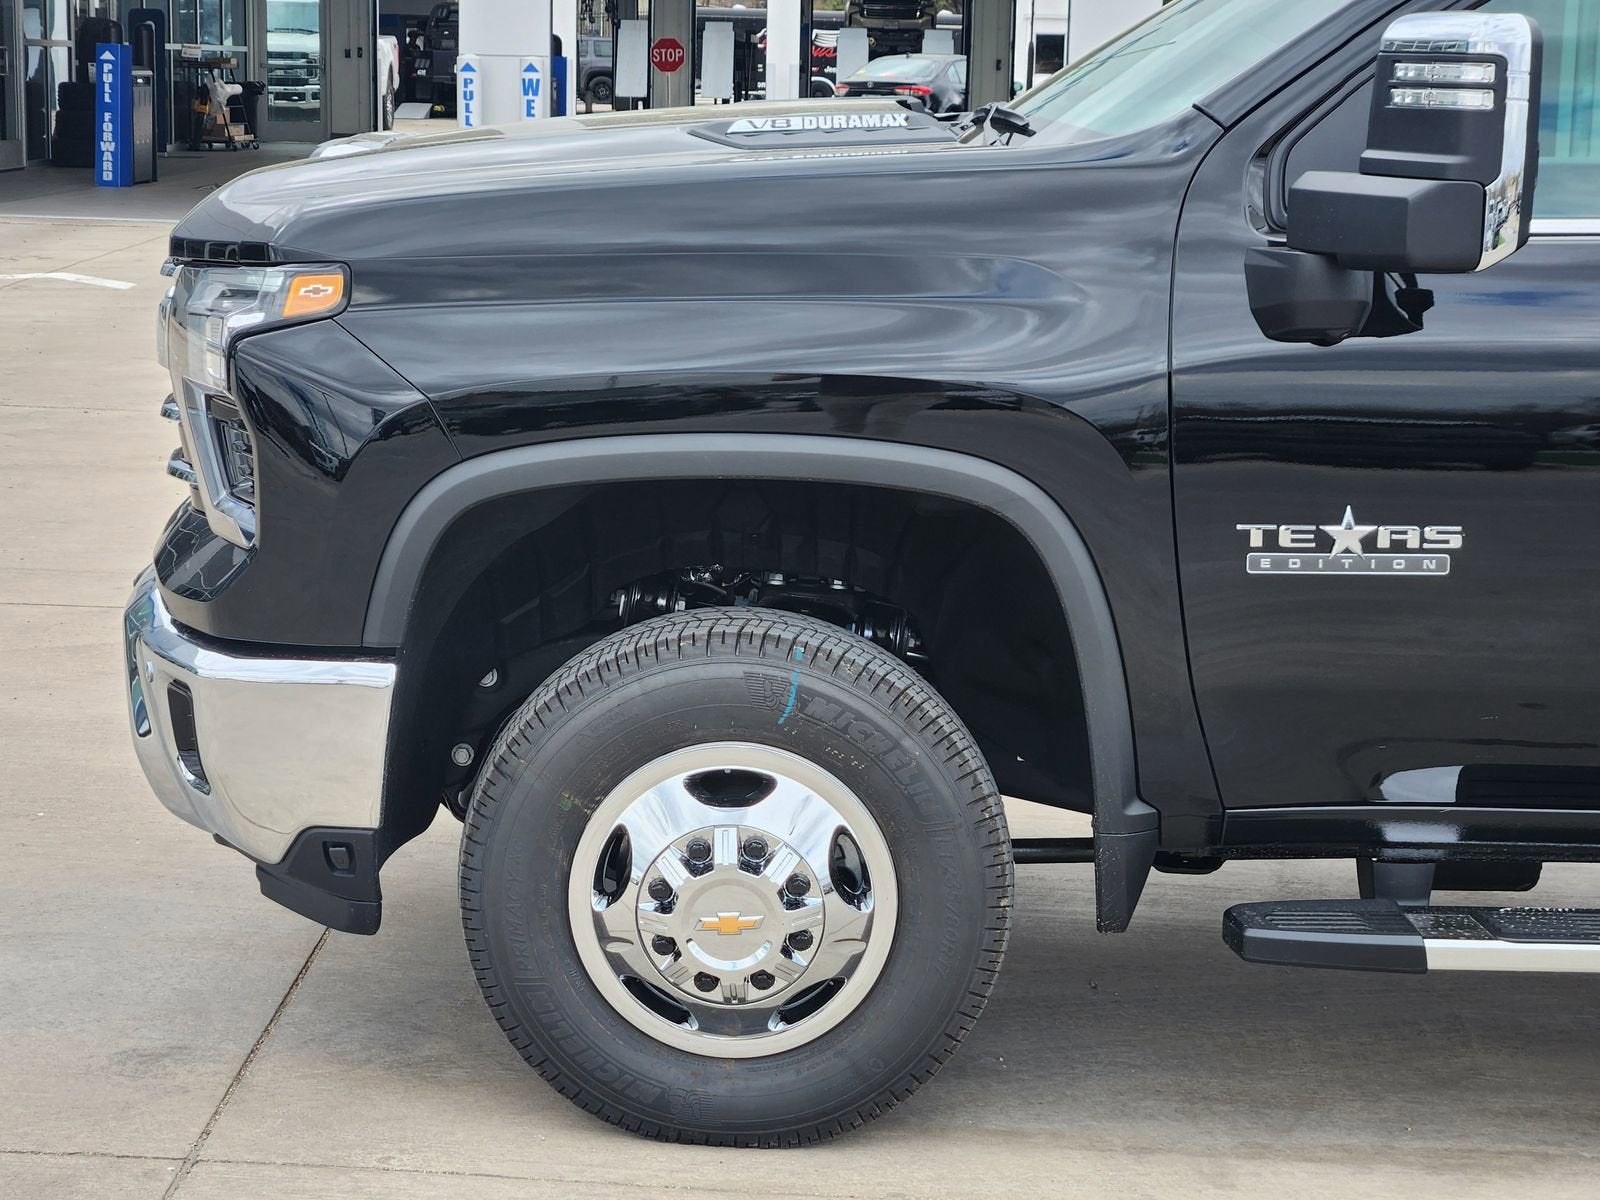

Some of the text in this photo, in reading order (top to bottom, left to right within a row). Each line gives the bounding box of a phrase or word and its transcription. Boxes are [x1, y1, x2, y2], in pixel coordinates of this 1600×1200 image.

[652, 48, 684, 63] STOP
[100, 63, 116, 181] PULL FORWARD
[463, 78, 474, 127] PULL
[803, 113, 909, 130] DURAMAX
[1236, 504, 1463, 551] TEXAS
[1260, 558, 1437, 570] EDITION
[802, 696, 953, 824] MICHELIN
[526, 990, 666, 1102] MICHELIN
